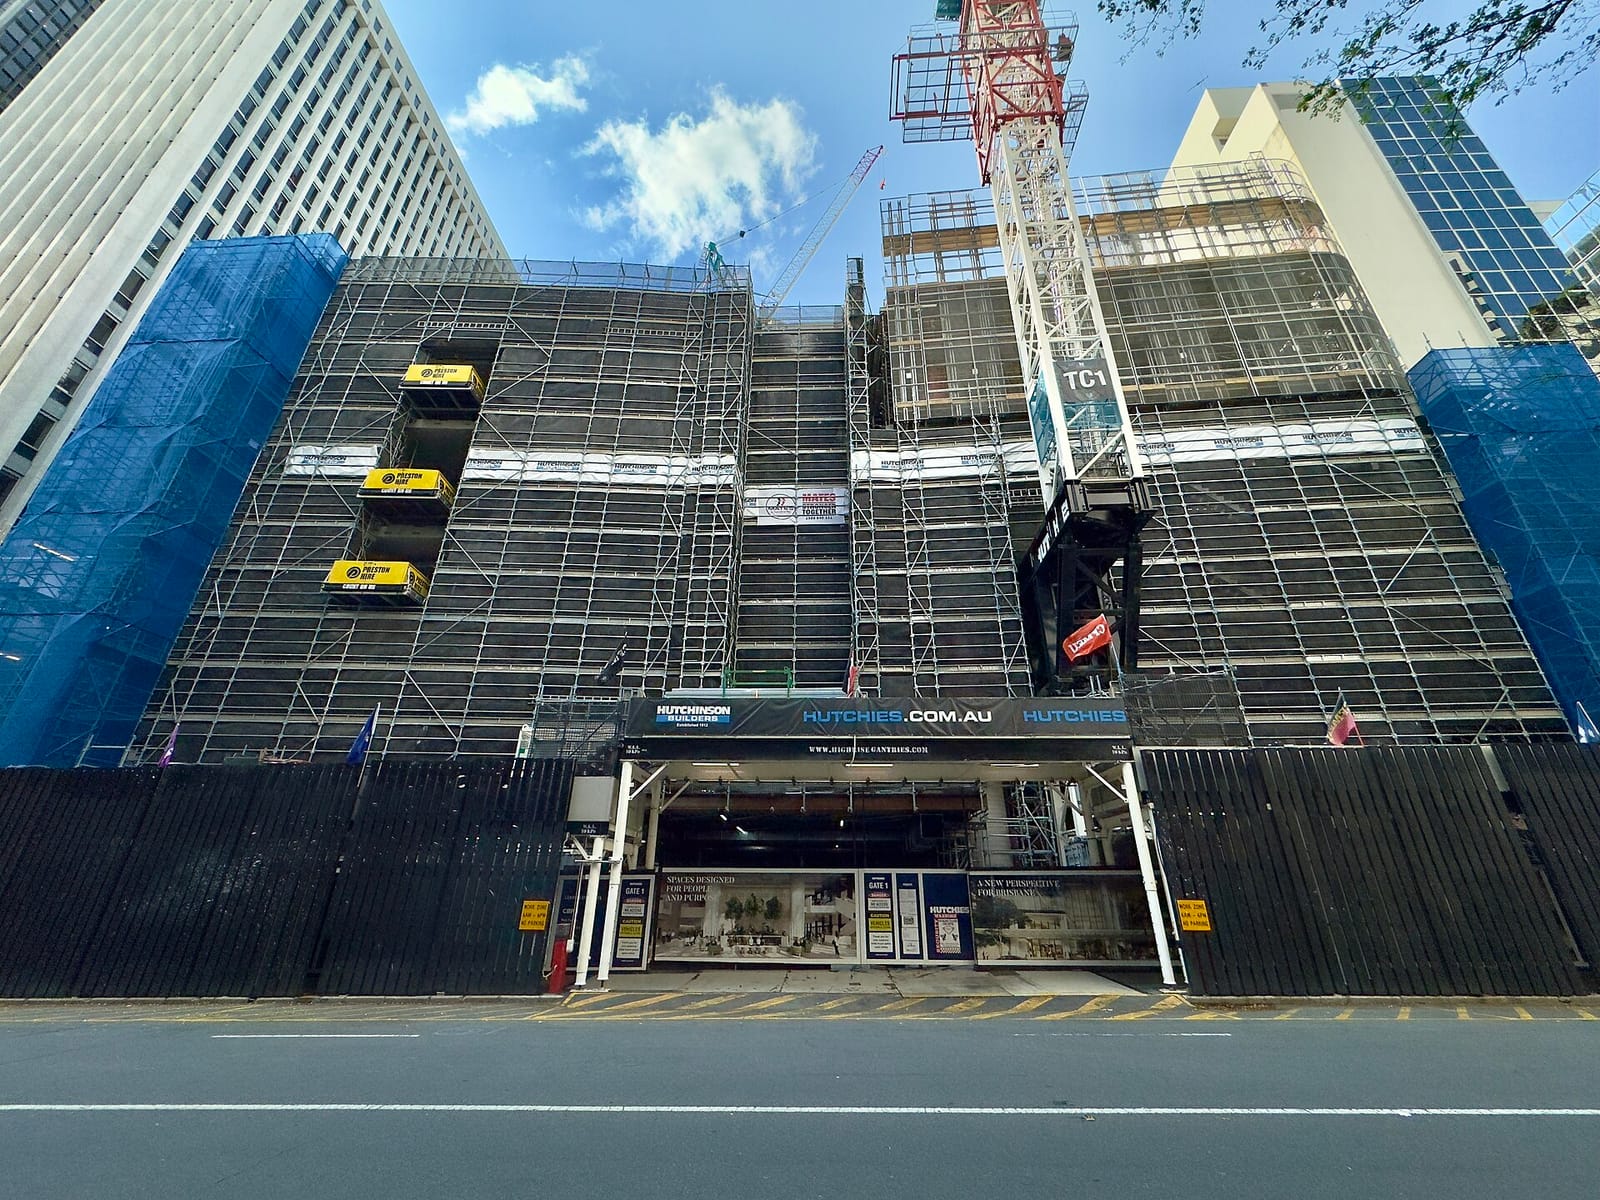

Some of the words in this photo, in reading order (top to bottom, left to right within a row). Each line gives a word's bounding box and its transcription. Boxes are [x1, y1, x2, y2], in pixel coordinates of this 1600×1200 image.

[1063, 369, 1107, 390] TC1
[656, 705, 731, 715] HUTCHINSON
[803, 710, 992, 723] HUTCHIES.COM.AU
[1023, 710, 1127, 722] HUTCHIES
[666, 876, 695, 884] SPACES
[696, 876, 736, 884] DESIGNED
[1005, 879, 1061, 888] PERSPECTIVE
[625, 887, 640, 895] GATE
[977, 888, 994, 896] FOR
[930, 906, 970, 914] HUTCHIES
